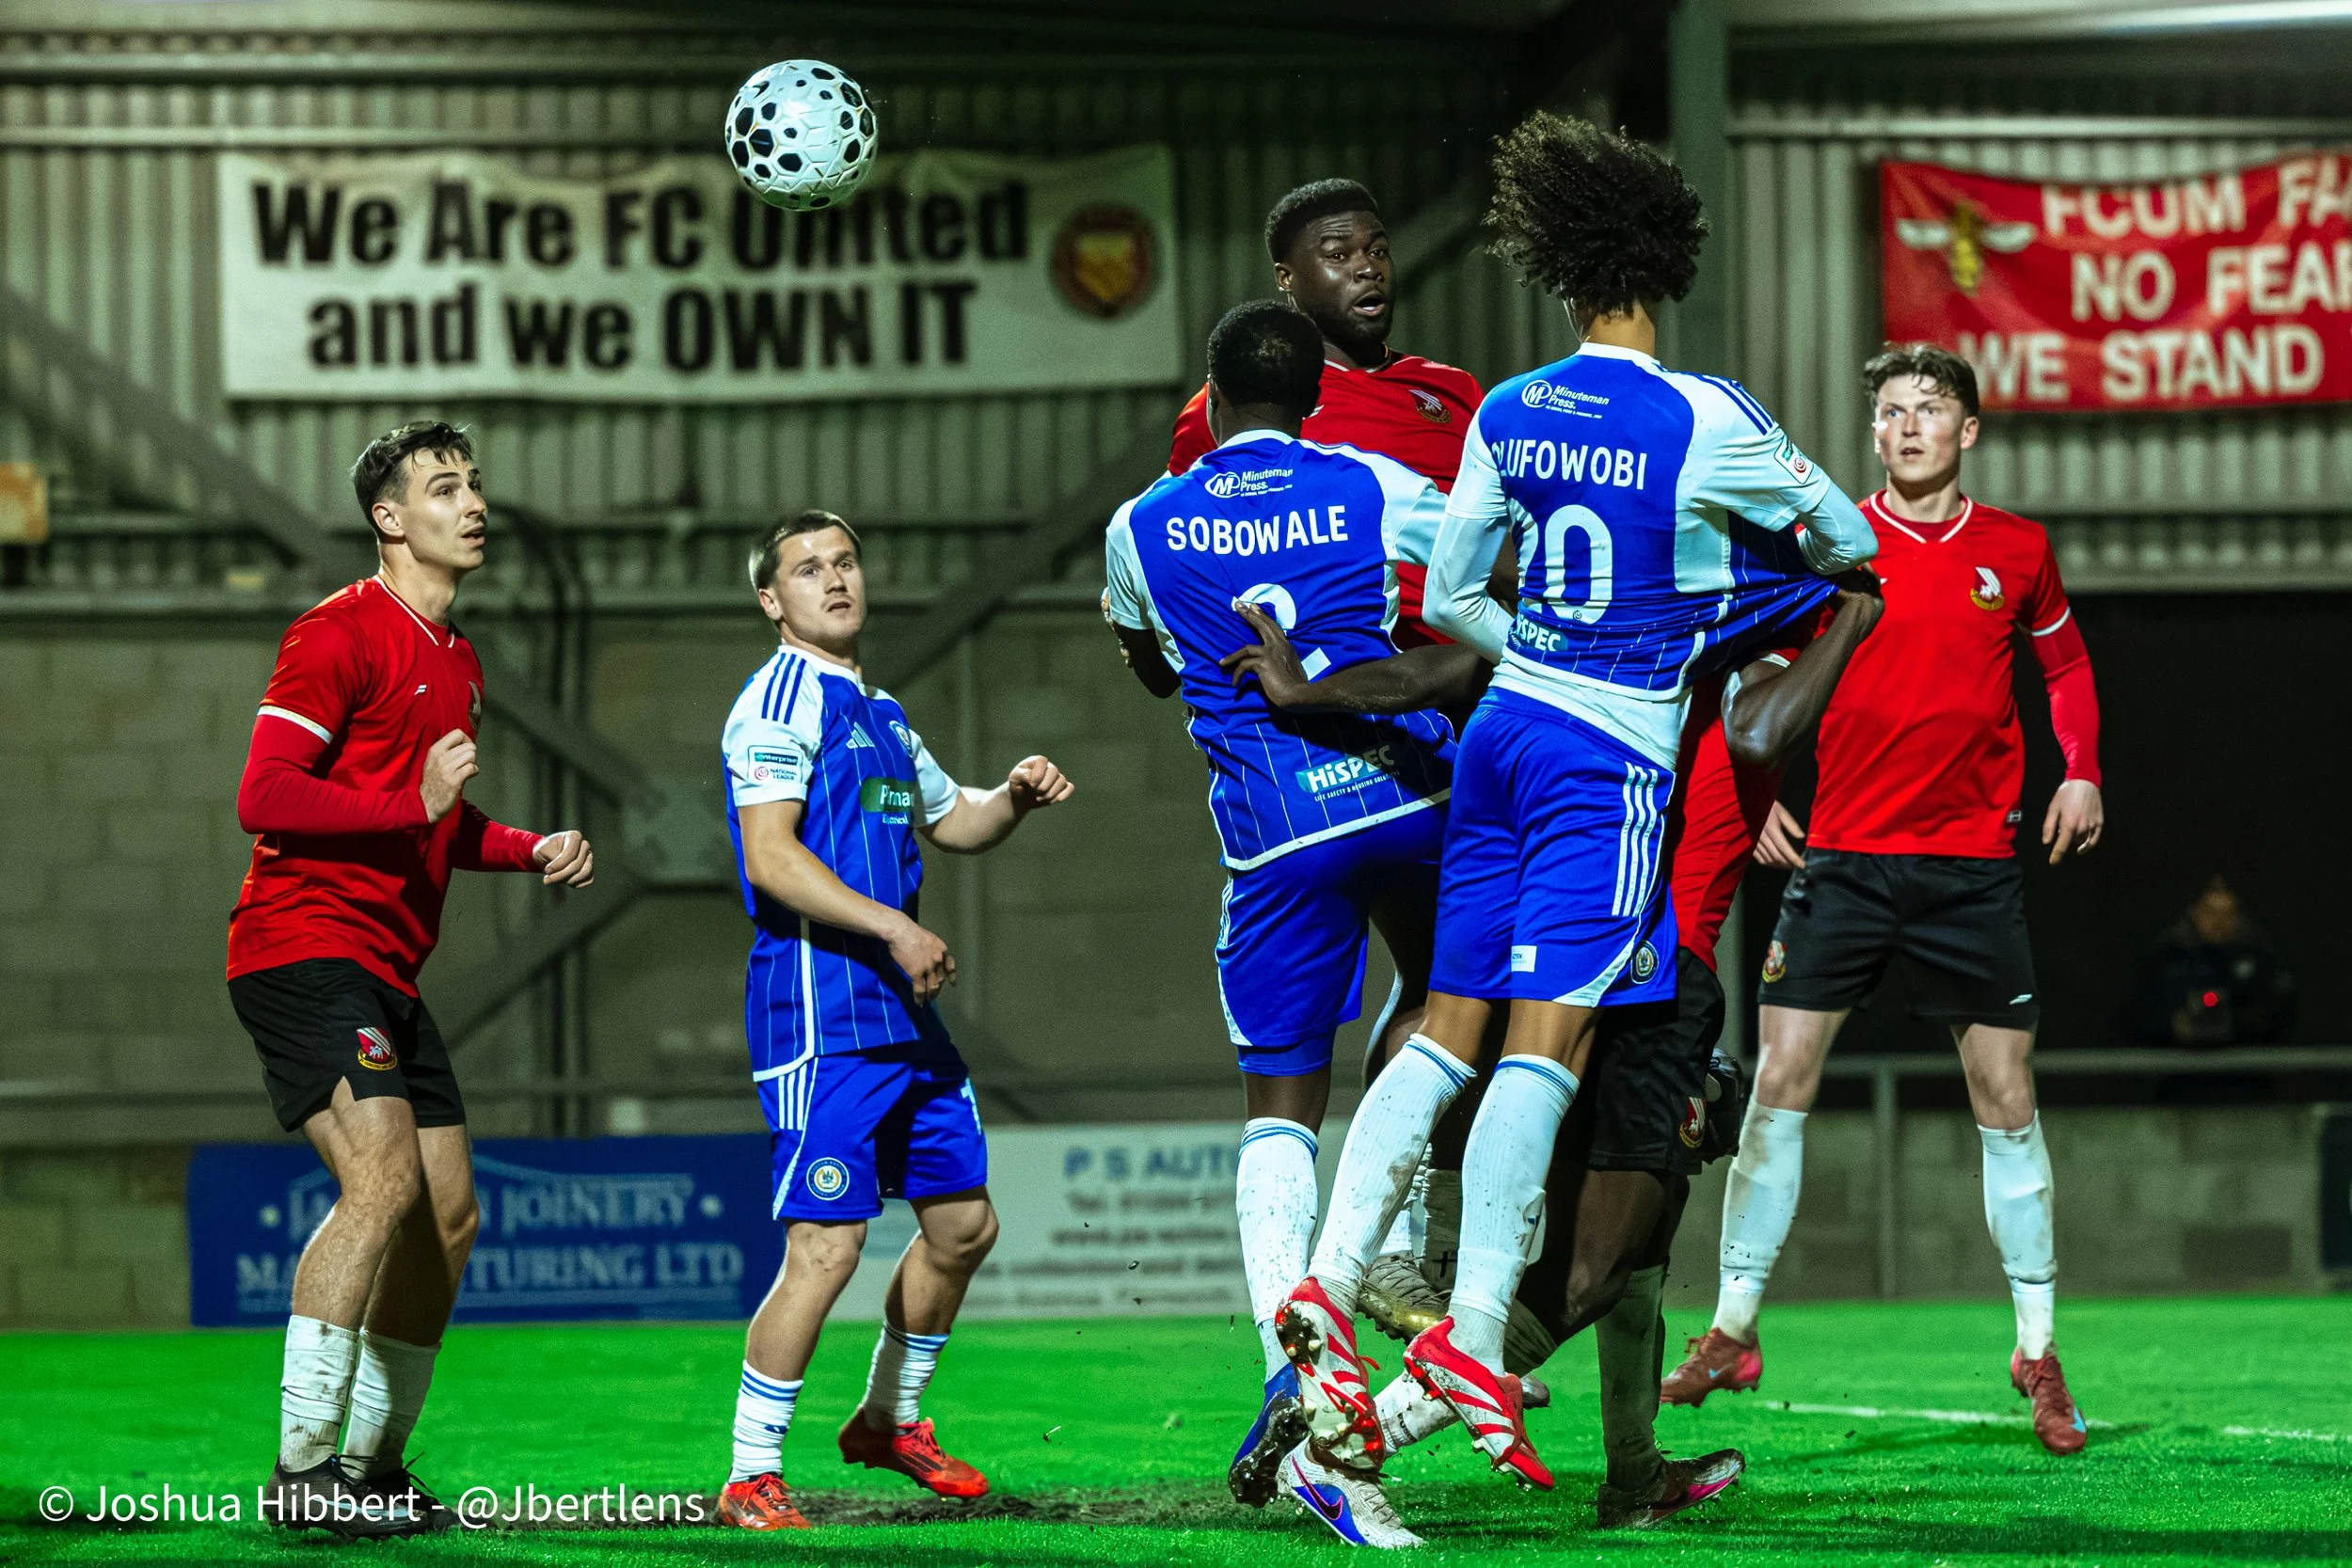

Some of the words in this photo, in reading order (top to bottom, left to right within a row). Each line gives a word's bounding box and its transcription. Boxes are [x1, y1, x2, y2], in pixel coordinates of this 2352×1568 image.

[251, 181, 399, 263] We
[423, 182, 577, 268] Are
[604, 189, 707, 270] FC
[2040, 175, 2246, 239] FCUM
[2071, 251, 2176, 322] NO
[308, 282, 479, 368] and
[501, 296, 632, 370] we
[662, 285, 875, 372] OWN
[900, 279, 977, 367] IT
[1957, 332, 2067, 401] WE
[2101, 325, 2326, 402] STAND
[1553, 385, 1610, 405] Minuteman
[1241, 468, 1294, 482] Minuteman
[1166, 504, 1349, 557] SOBOWALE
[1306, 745, 1394, 793] HiSPEC
[656, 1243, 744, 1285] LTD
